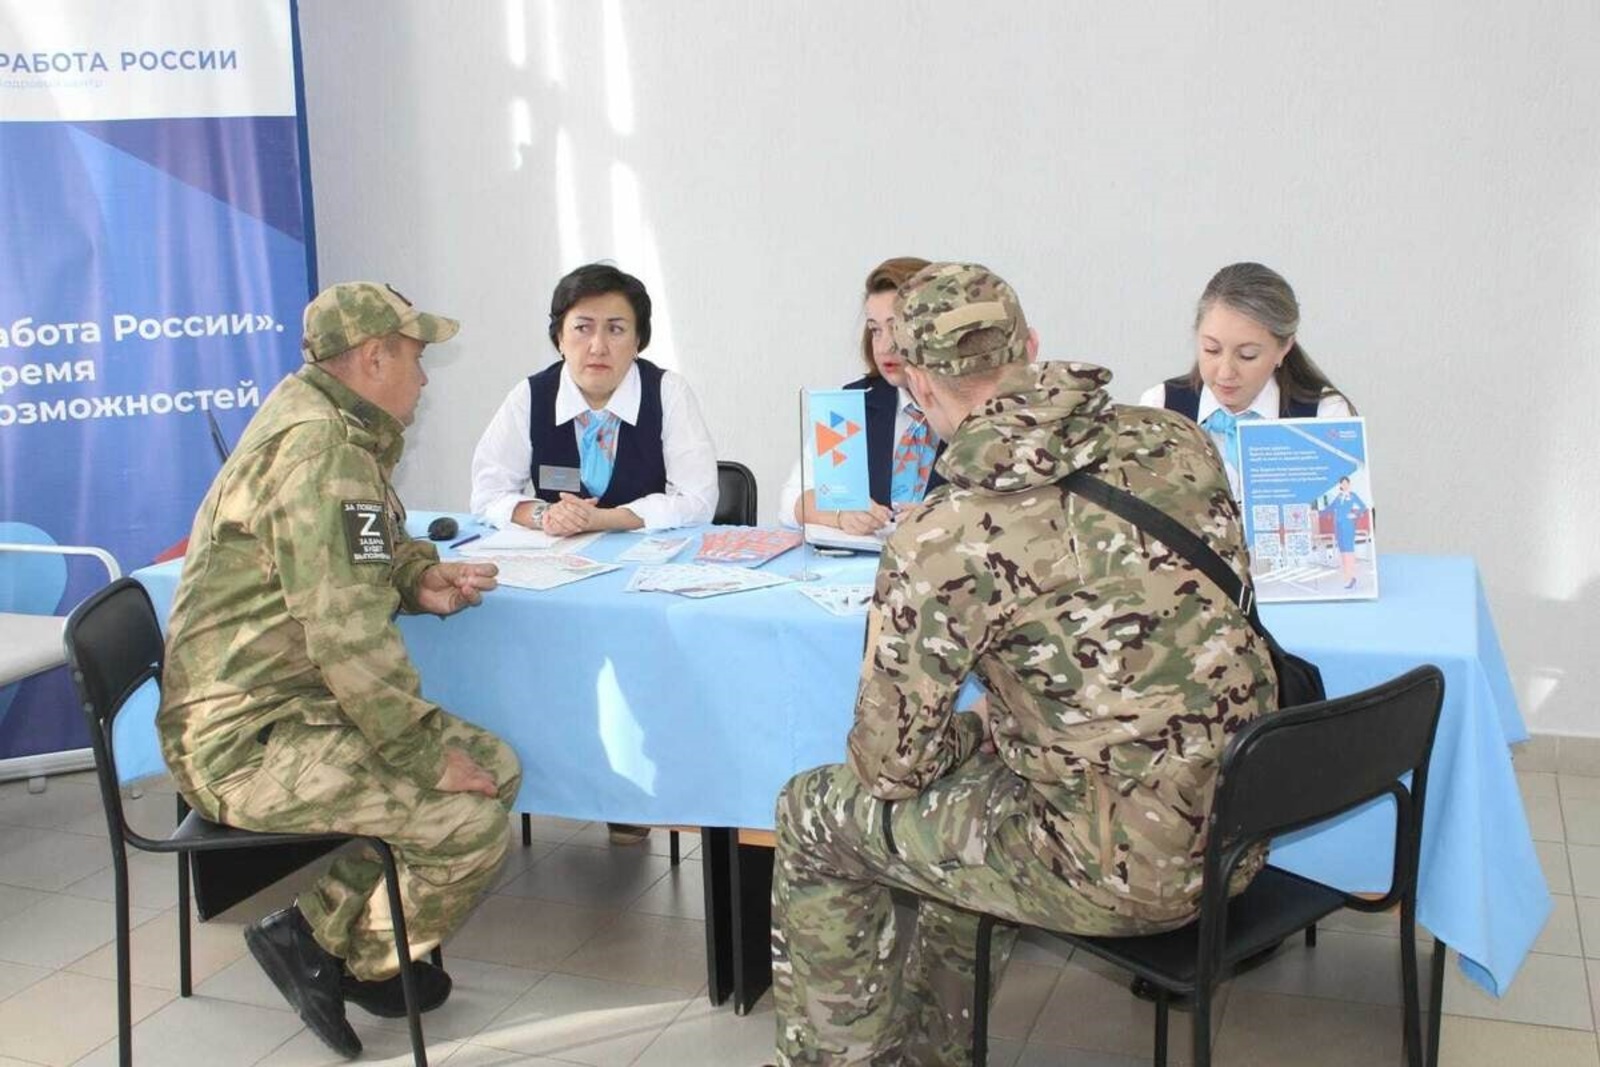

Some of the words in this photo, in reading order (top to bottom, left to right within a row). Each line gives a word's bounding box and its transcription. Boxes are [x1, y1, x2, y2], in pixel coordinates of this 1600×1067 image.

[120, 50, 238, 71] РОССИИ
[113, 313, 284, 341] России».
[0, 360, 96, 393] ремя
[357, 512, 381, 536] Z
